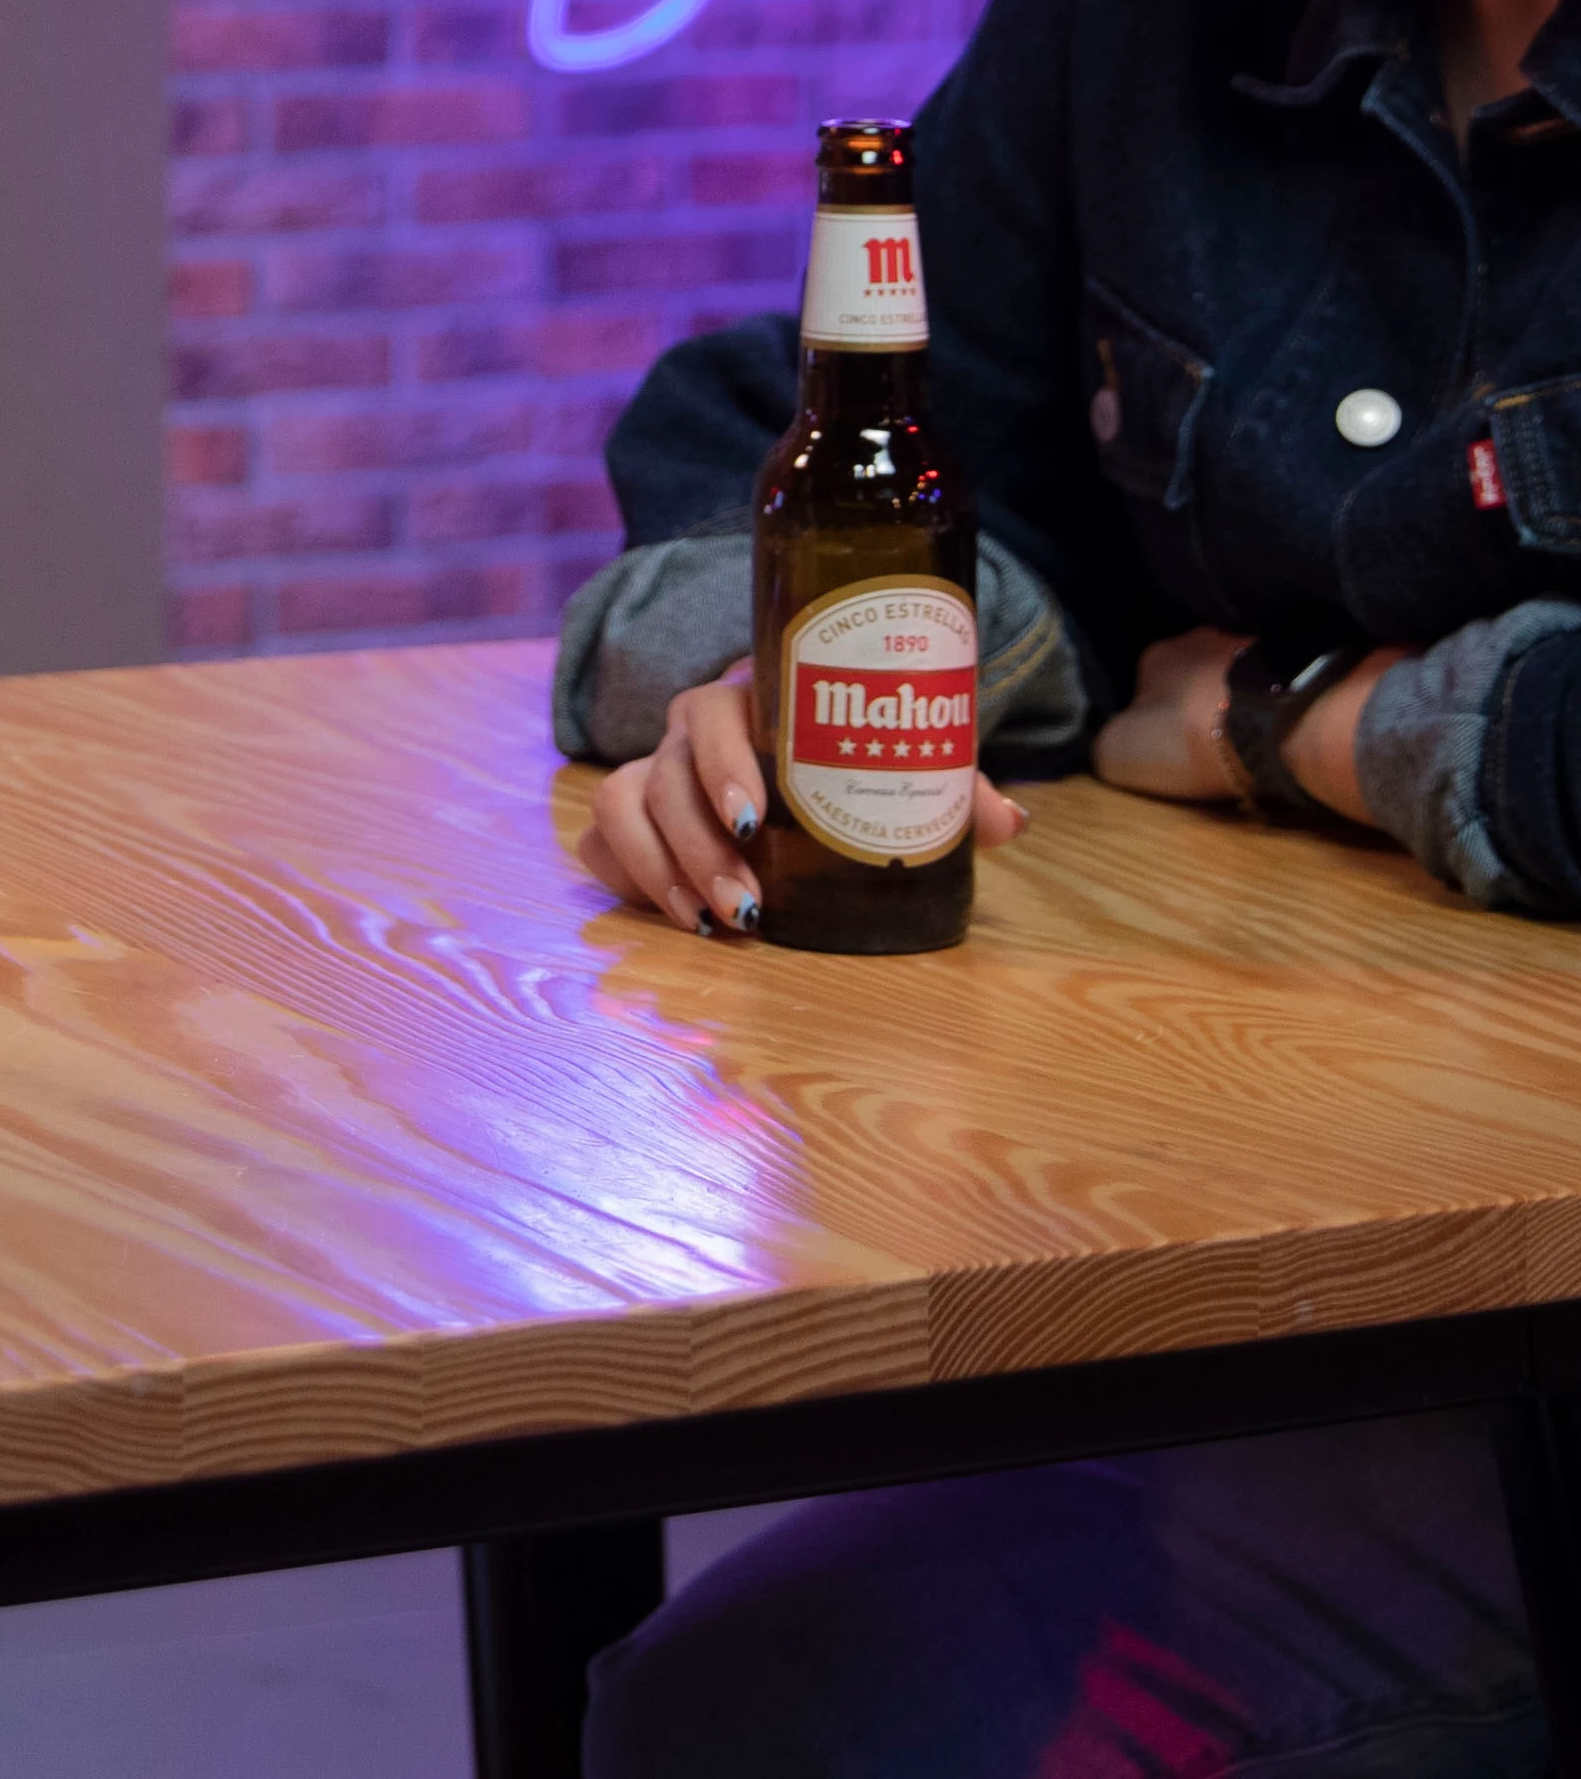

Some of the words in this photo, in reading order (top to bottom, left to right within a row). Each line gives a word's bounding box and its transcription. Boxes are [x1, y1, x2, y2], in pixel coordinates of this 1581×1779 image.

[818, 607, 878, 644] CINCO
[884, 602, 970, 645] ESTRELLAS
[883, 634, 930, 653] 1890
[812, 679, 971, 731] Mahou
